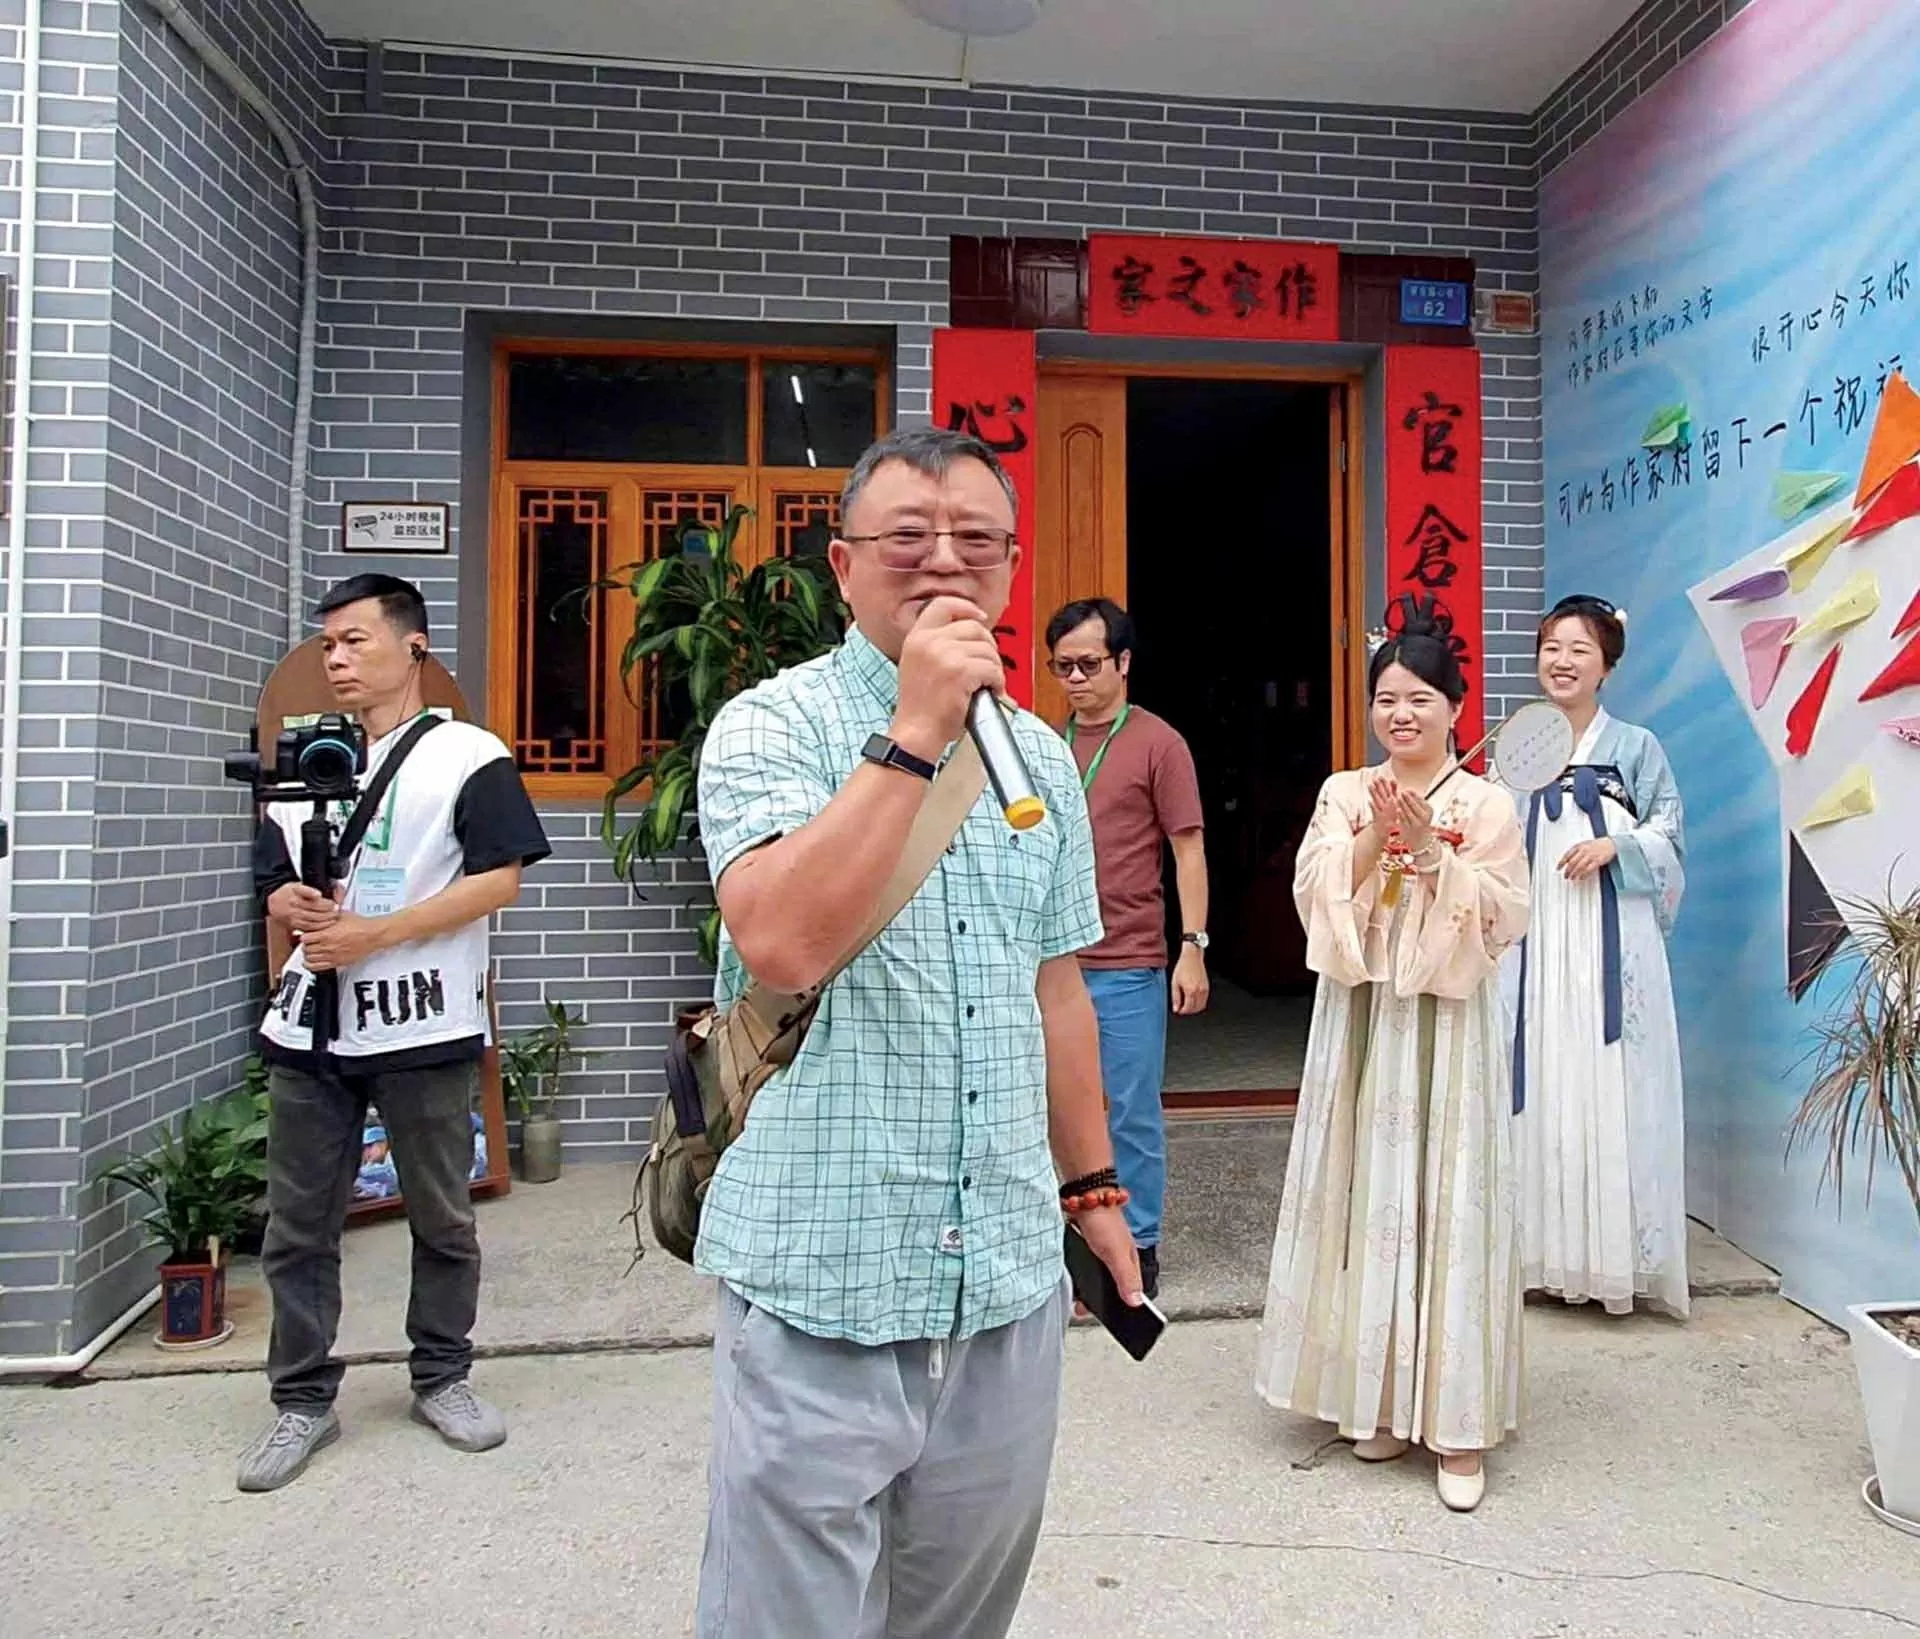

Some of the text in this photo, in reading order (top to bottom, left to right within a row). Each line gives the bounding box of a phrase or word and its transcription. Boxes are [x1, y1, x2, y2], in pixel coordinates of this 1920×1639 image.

[1423, 300, 1445, 317] 62
[1752, 260, 1910, 364] 很开心今天你
[353, 969, 446, 1032] FUN
